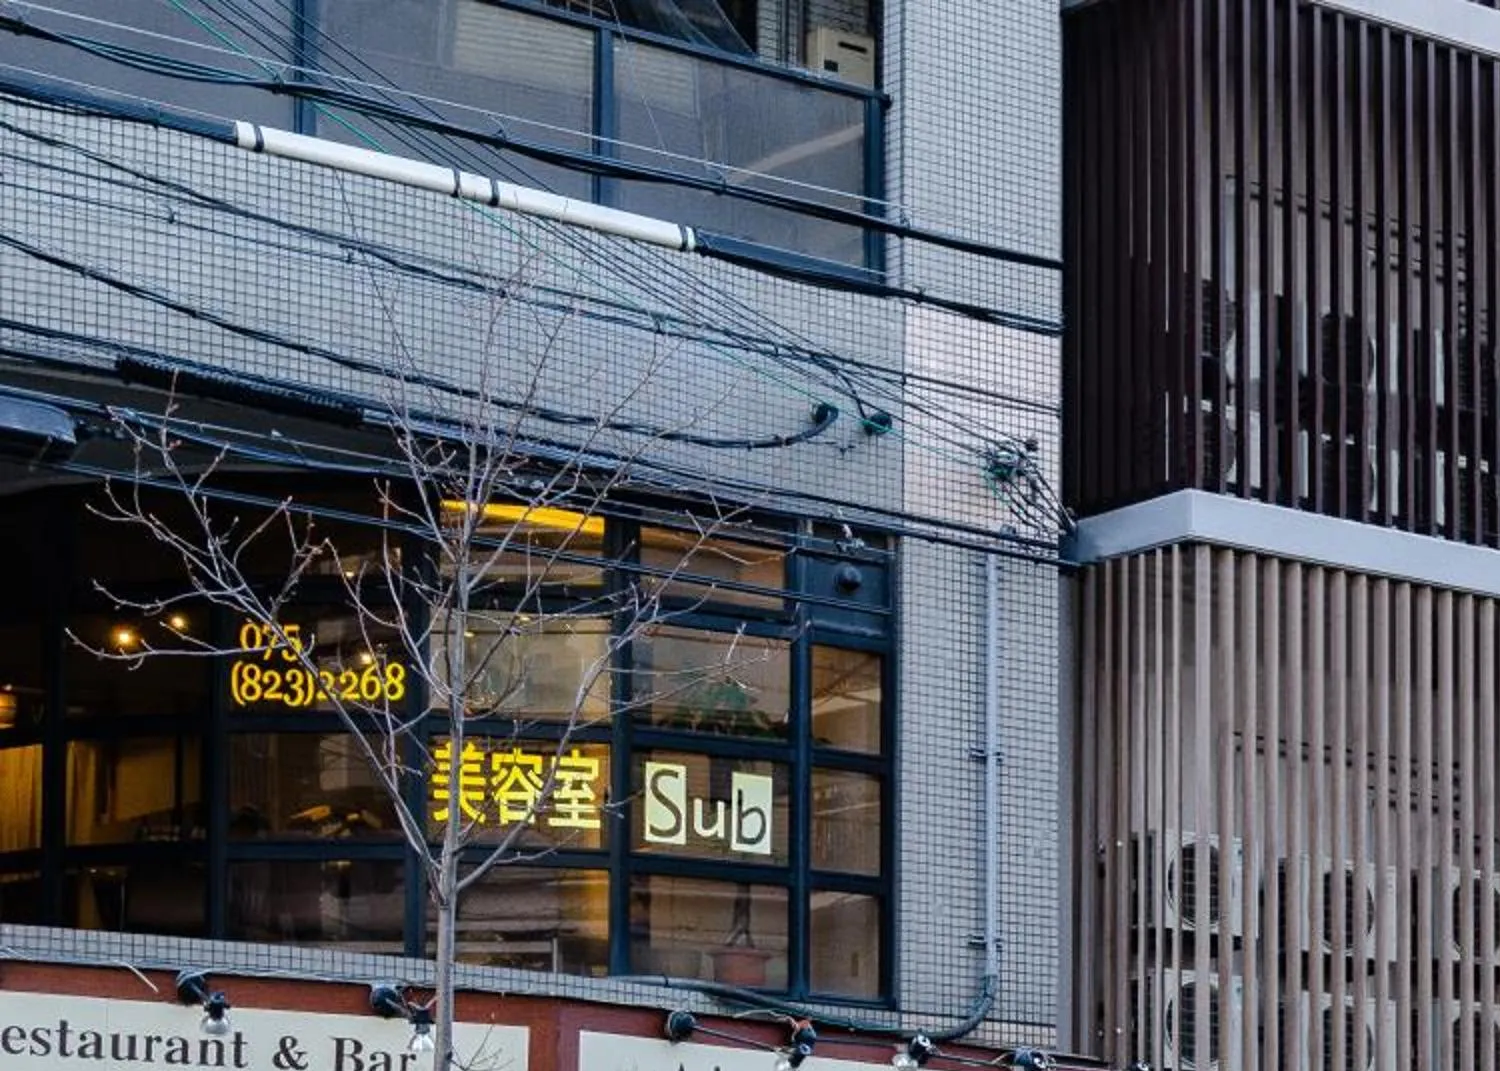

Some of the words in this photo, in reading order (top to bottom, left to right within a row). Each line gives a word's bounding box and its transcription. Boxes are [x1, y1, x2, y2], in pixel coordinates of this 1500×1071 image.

[239, 621, 303, 662] 075
[231, 660, 406, 707] (823)2268
[431, 741, 601, 829] 美容室
[647, 766, 770, 848] Sub
[0, 1019, 249, 1069] estaurant
[272, 1035, 309, 1071] &
